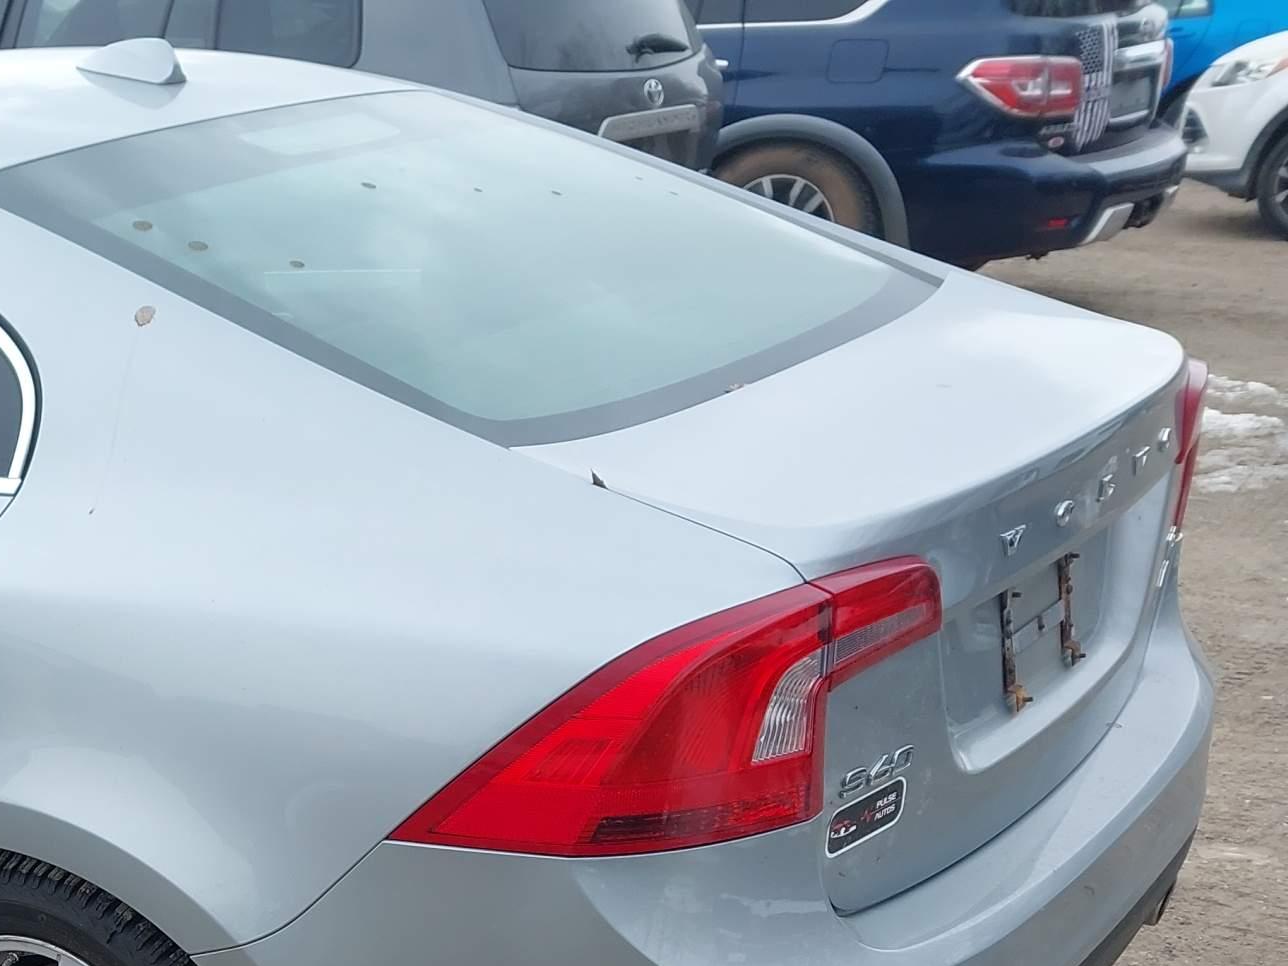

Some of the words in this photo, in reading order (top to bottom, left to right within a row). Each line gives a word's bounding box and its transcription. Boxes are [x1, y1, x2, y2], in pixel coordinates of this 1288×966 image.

[1000, 427, 1171, 556] VOLVO
[839, 745, 914, 799] S60
[874, 804, 896, 821] AUTOS
[876, 791, 897, 808] PULSE
